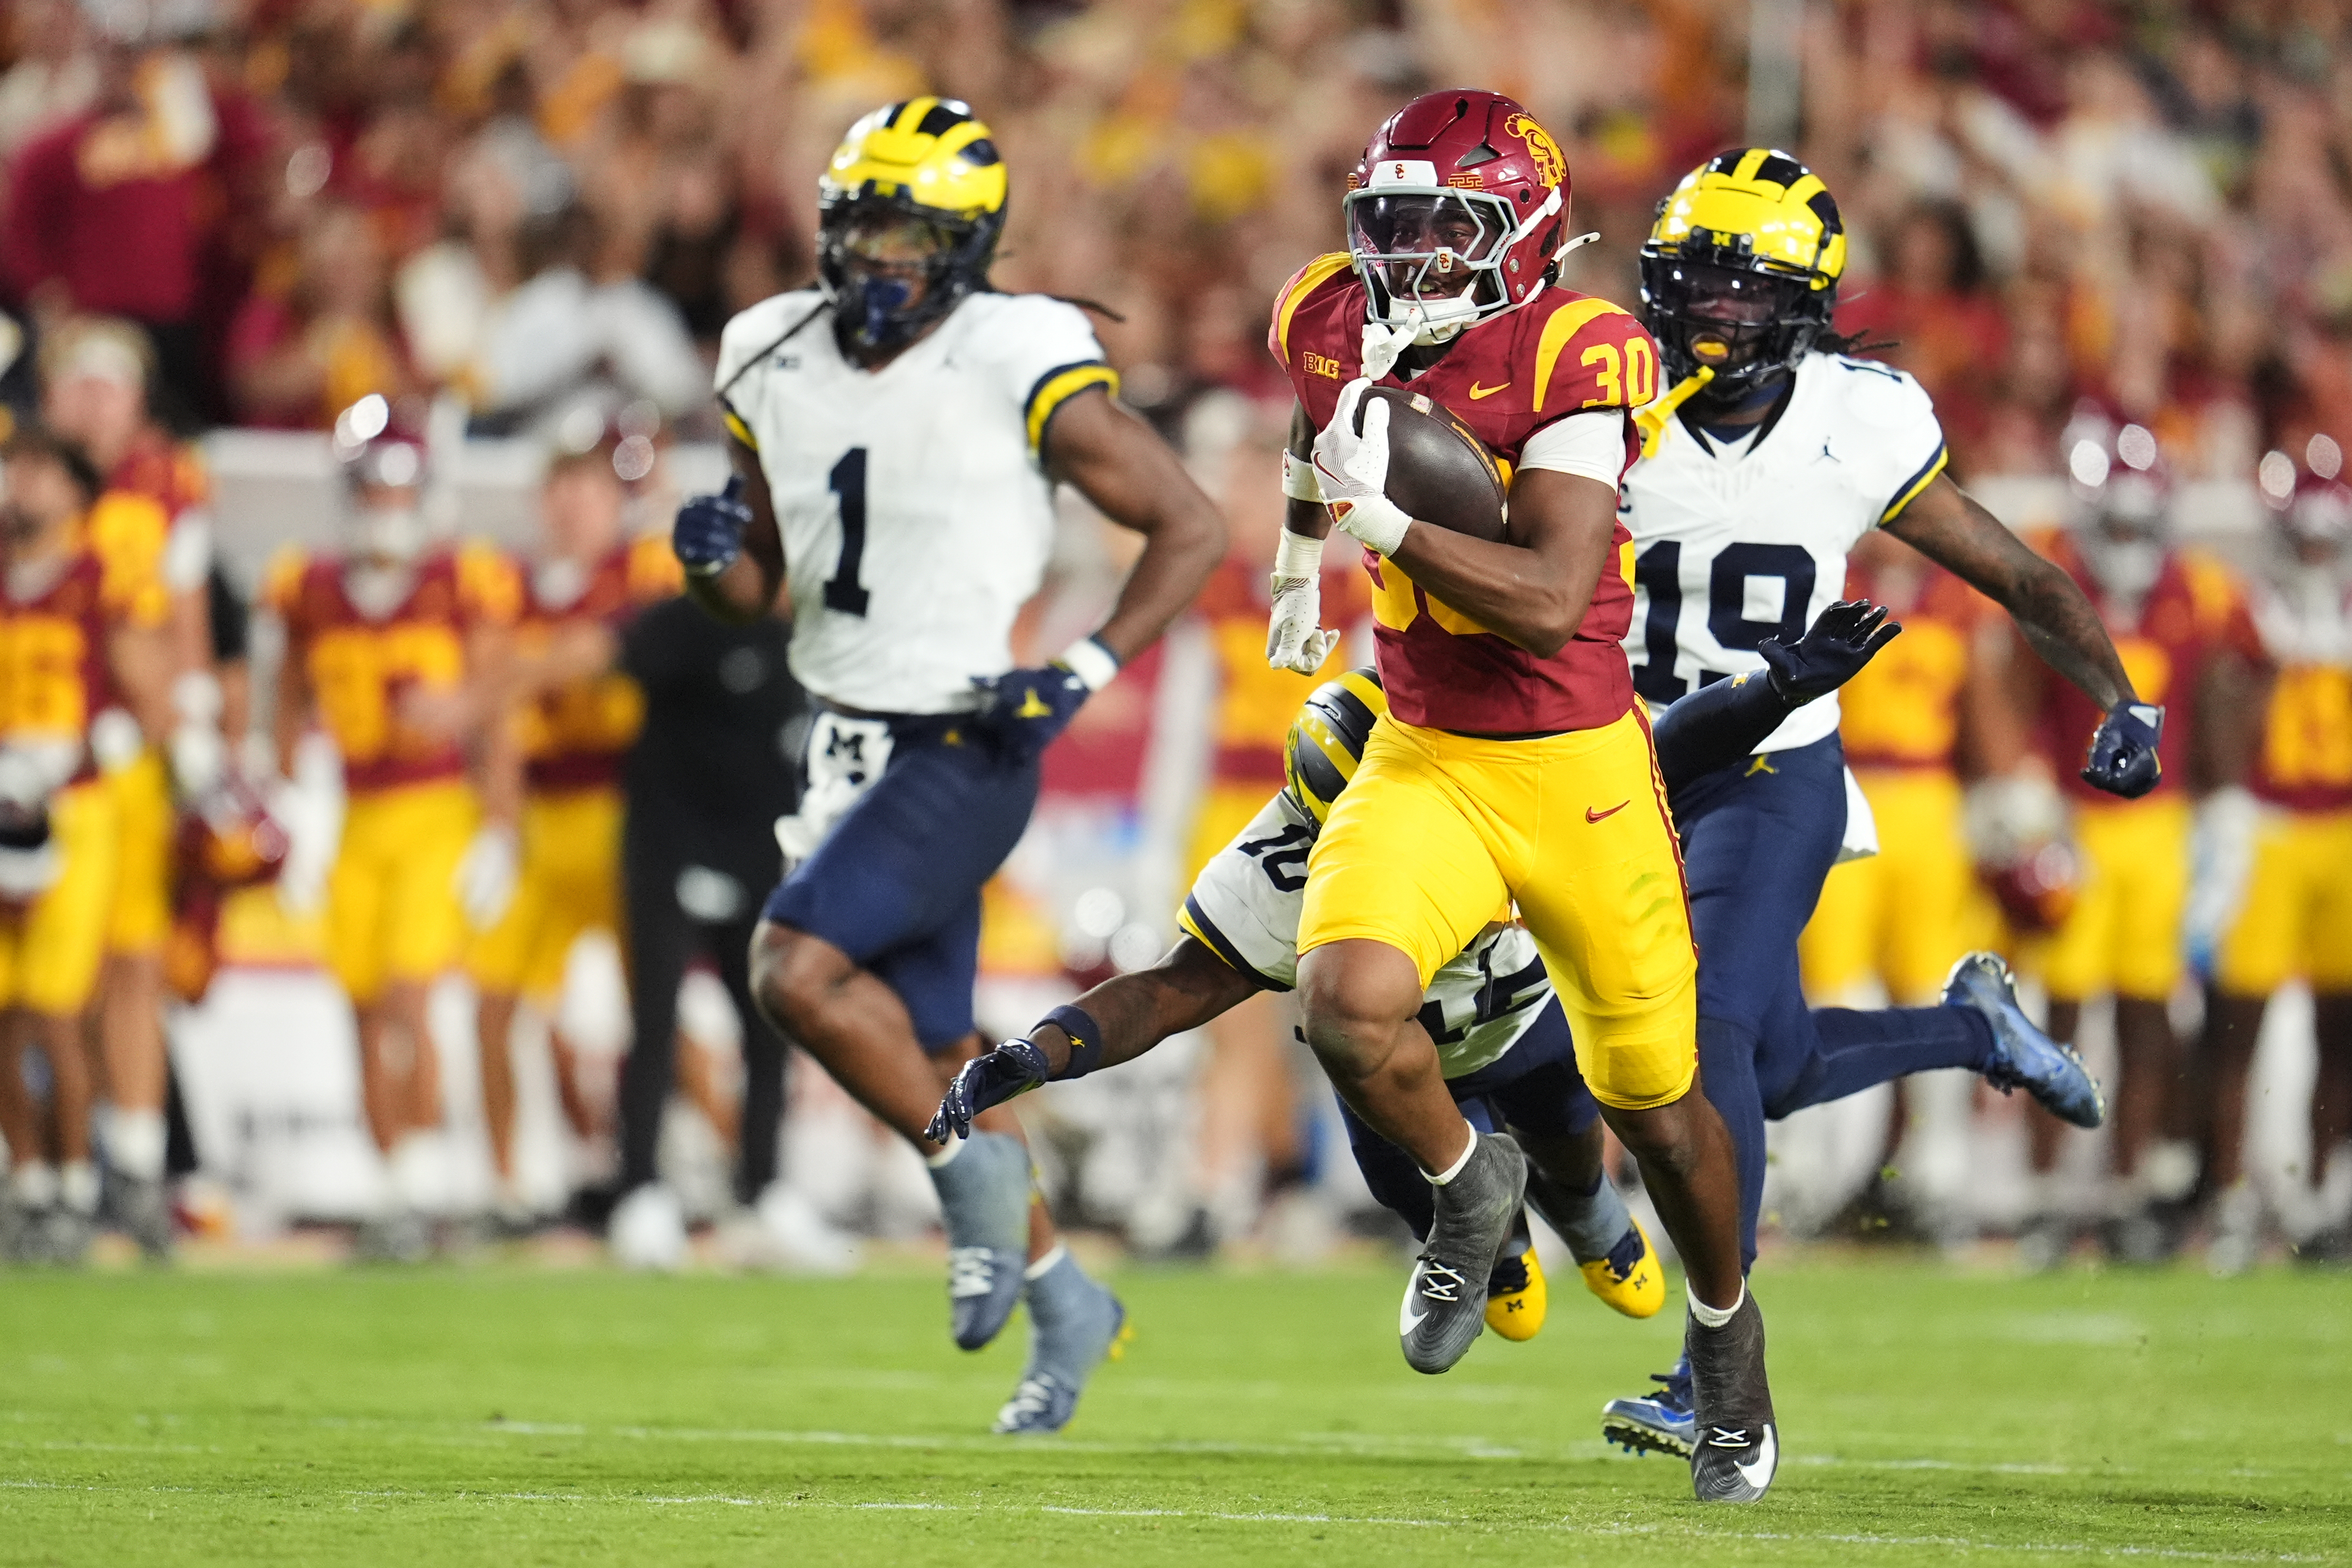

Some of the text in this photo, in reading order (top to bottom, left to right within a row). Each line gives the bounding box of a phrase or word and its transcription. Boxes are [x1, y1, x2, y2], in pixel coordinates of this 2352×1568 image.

[1712, 231, 1731, 247] M
[1580, 336, 1653, 409] 30
[822, 447, 869, 618] 1
[1633, 540, 1816, 706] 19
[826, 726, 864, 761] M
[1633, 1273, 1648, 1291] M
[1505, 1298, 1524, 1312] M
